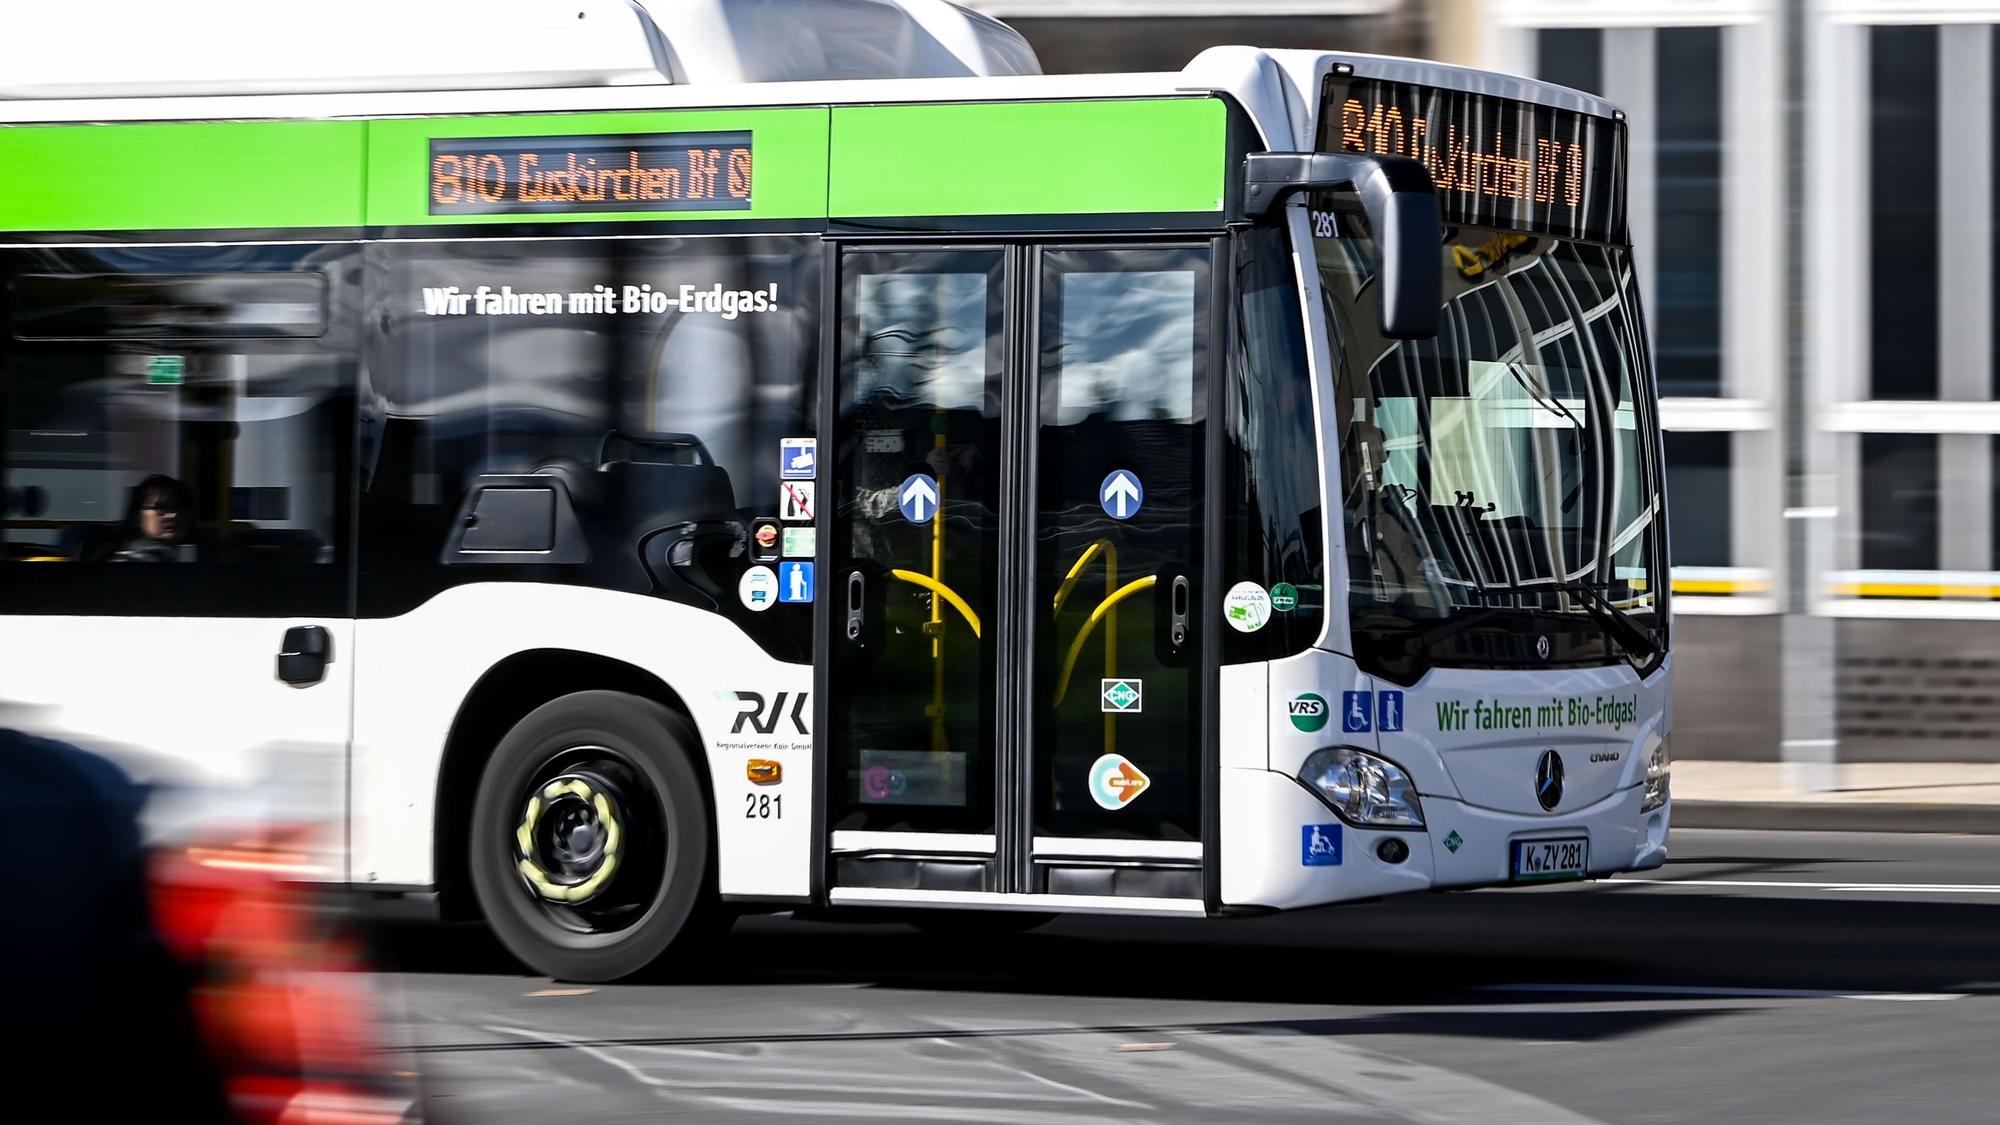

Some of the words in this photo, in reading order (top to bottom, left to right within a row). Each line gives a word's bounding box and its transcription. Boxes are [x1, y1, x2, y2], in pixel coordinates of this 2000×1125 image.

[432, 154, 506, 204] 810
[518, 151, 680, 202] Euskirchen
[686, 149, 721, 199] Bf
[1312, 210, 1339, 238] 281
[422, 286, 472, 316] Wir
[473, 285, 563, 315] fahren
[568, 284, 617, 314] mit
[622, 282, 778, 321] Bio-Erdgas!
[1288, 701, 1320, 714] VRS
[1436, 701, 1470, 732] Wir
[1474, 699, 1532, 731] fahren
[1537, 698, 1564, 728] mit
[1568, 694, 1638, 731] Bio-Erdgas!
[746, 793, 782, 820] 281
[1526, 845, 1536, 872] K
